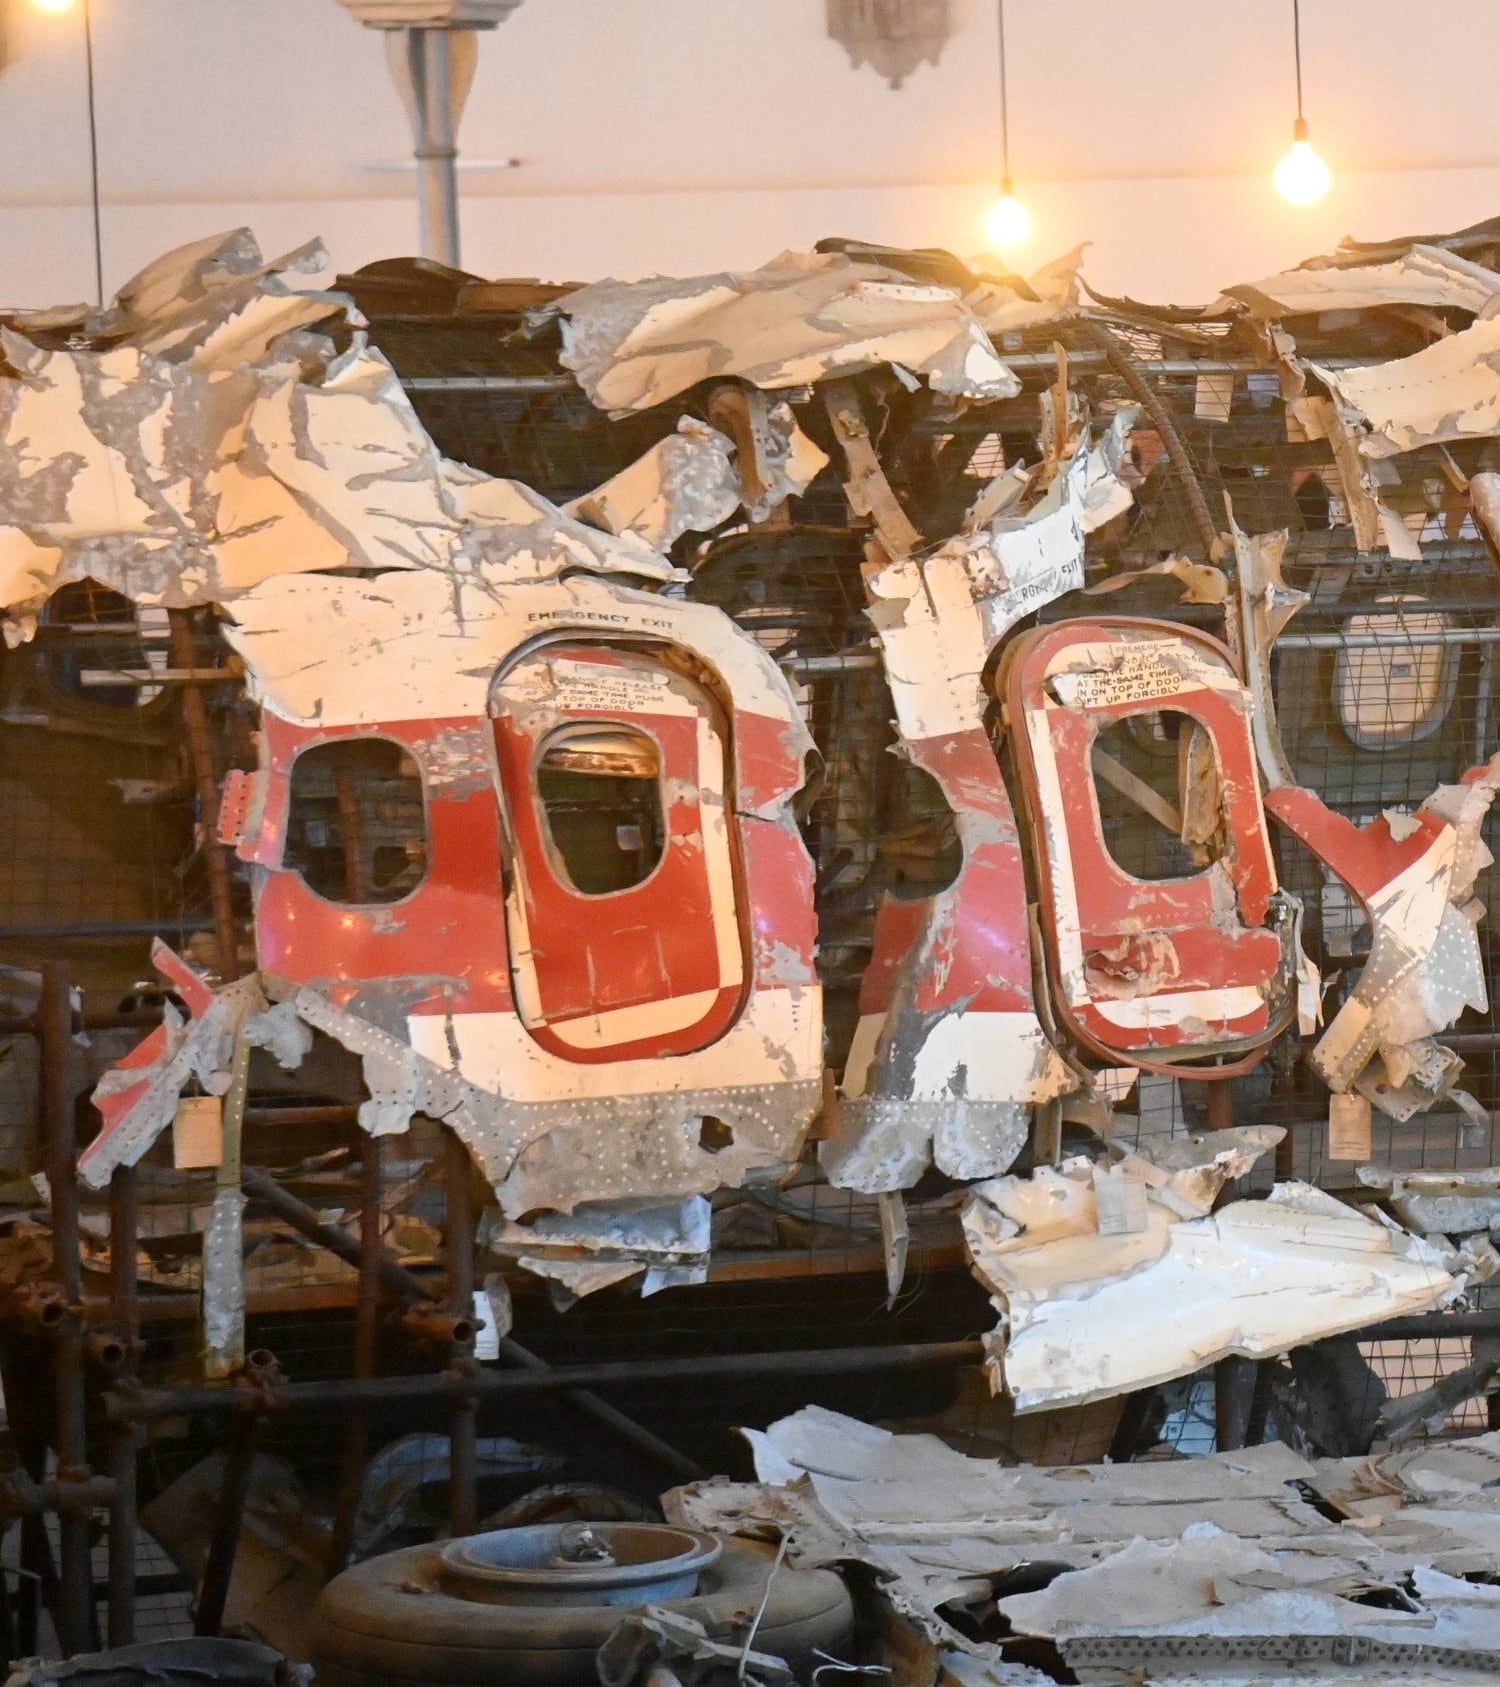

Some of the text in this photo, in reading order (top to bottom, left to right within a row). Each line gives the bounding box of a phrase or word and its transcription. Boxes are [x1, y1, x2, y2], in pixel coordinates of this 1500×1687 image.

[527, 611, 673, 629] EMEGENCY EXIT
[1077, 679, 1089, 688] AT
[1116, 672, 1144, 684] SAME
[1149, 668, 1176, 679] TIME
[1077, 688, 1088, 698] IN
[1091, 686, 1106, 697] ON
[1111, 683, 1134, 694] TOP
[1137, 680, 1152, 690] OF
[1105, 694, 1121, 704] UP
[1126, 685, 1181, 701] FORCIBLY
[610, 698, 645, 706] DOOR
